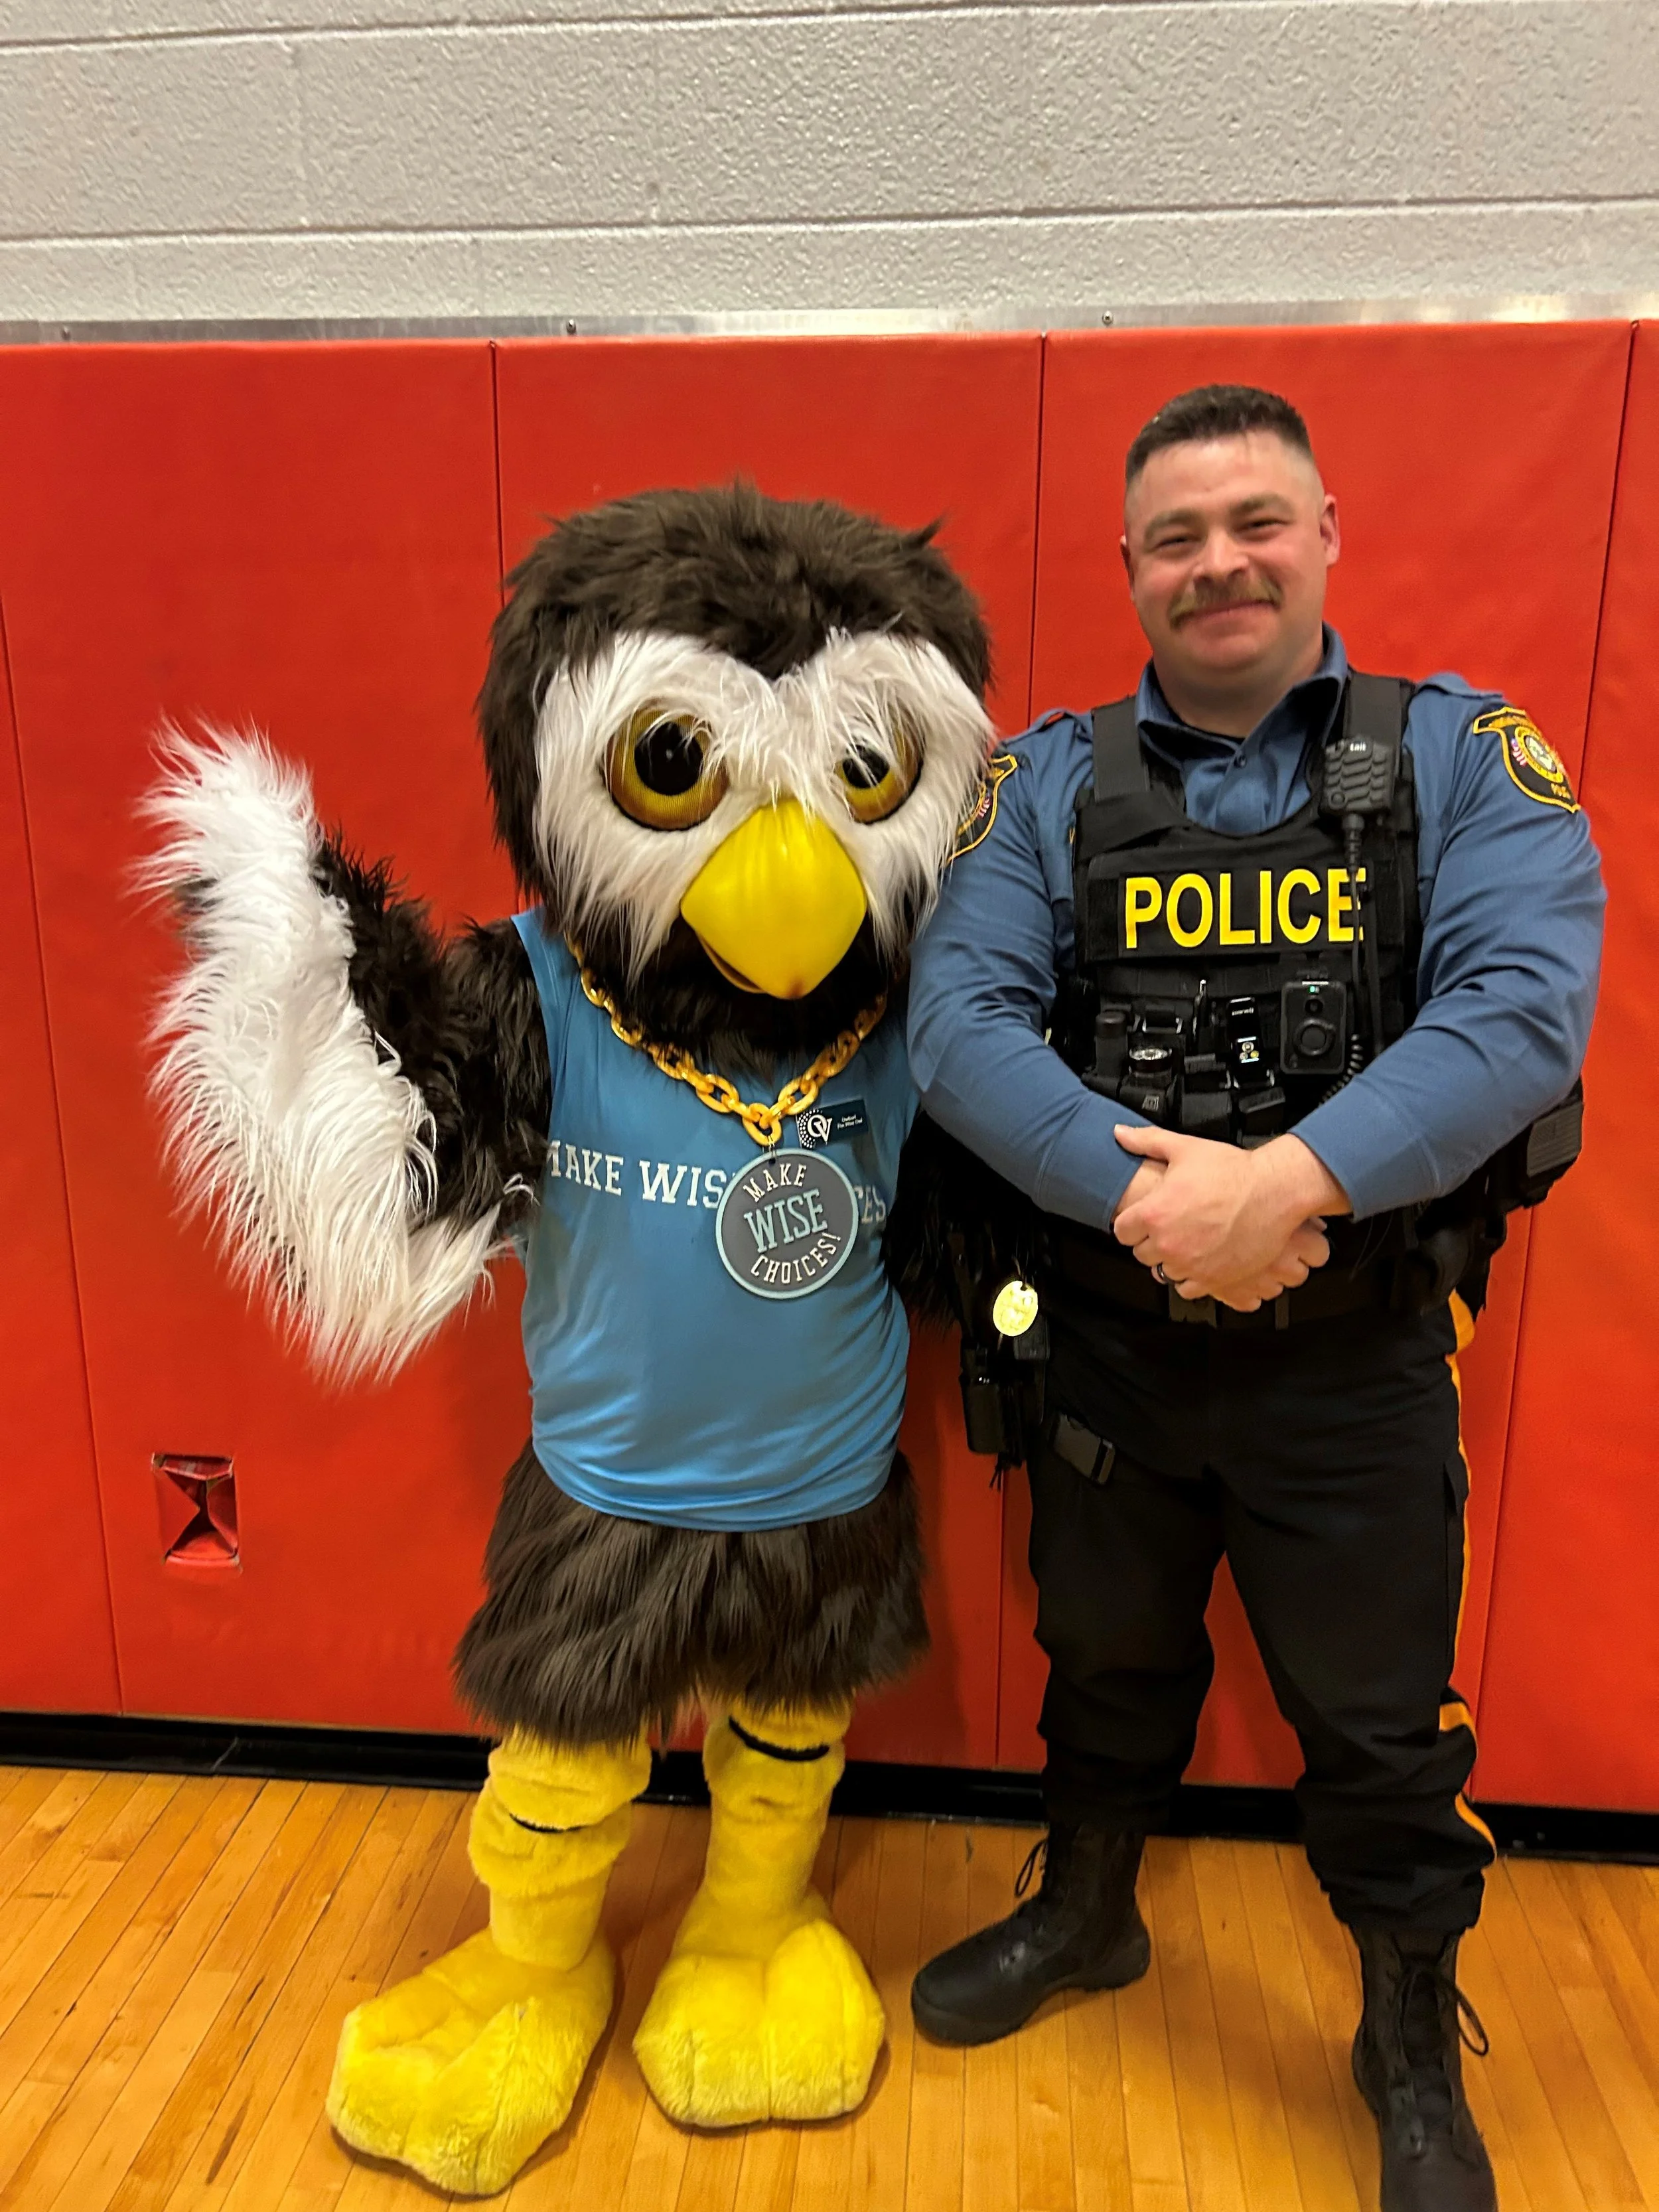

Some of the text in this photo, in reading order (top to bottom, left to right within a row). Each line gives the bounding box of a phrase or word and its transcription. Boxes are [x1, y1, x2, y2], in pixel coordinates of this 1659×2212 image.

[1125, 868, 1366, 948] POLICE
[639, 1160, 735, 1209] WIS
[743, 1163, 808, 1203] MAKE
[743, 1187, 828, 1254] WISE
[751, 1232, 841, 1284] CHOICES!
